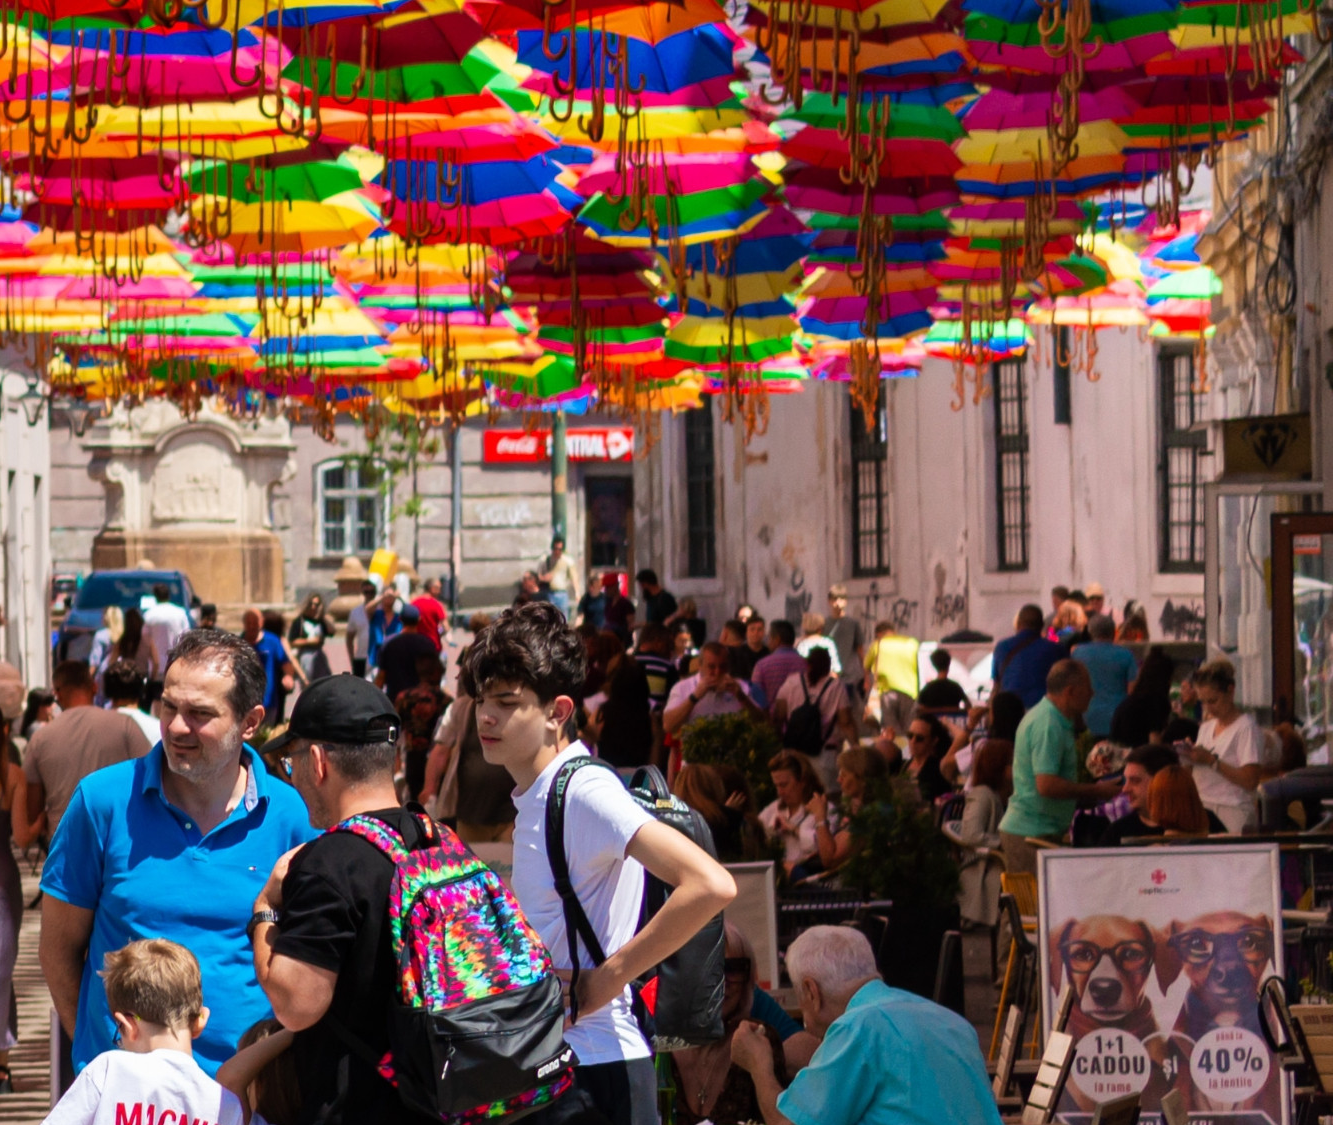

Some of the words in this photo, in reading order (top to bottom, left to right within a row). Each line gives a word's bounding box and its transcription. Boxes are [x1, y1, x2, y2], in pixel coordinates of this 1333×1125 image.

[1095, 1035, 1124, 1054] 1+1
[1076, 1055, 1145, 1075] CADOU
[1198, 1046, 1263, 1074] 40%
